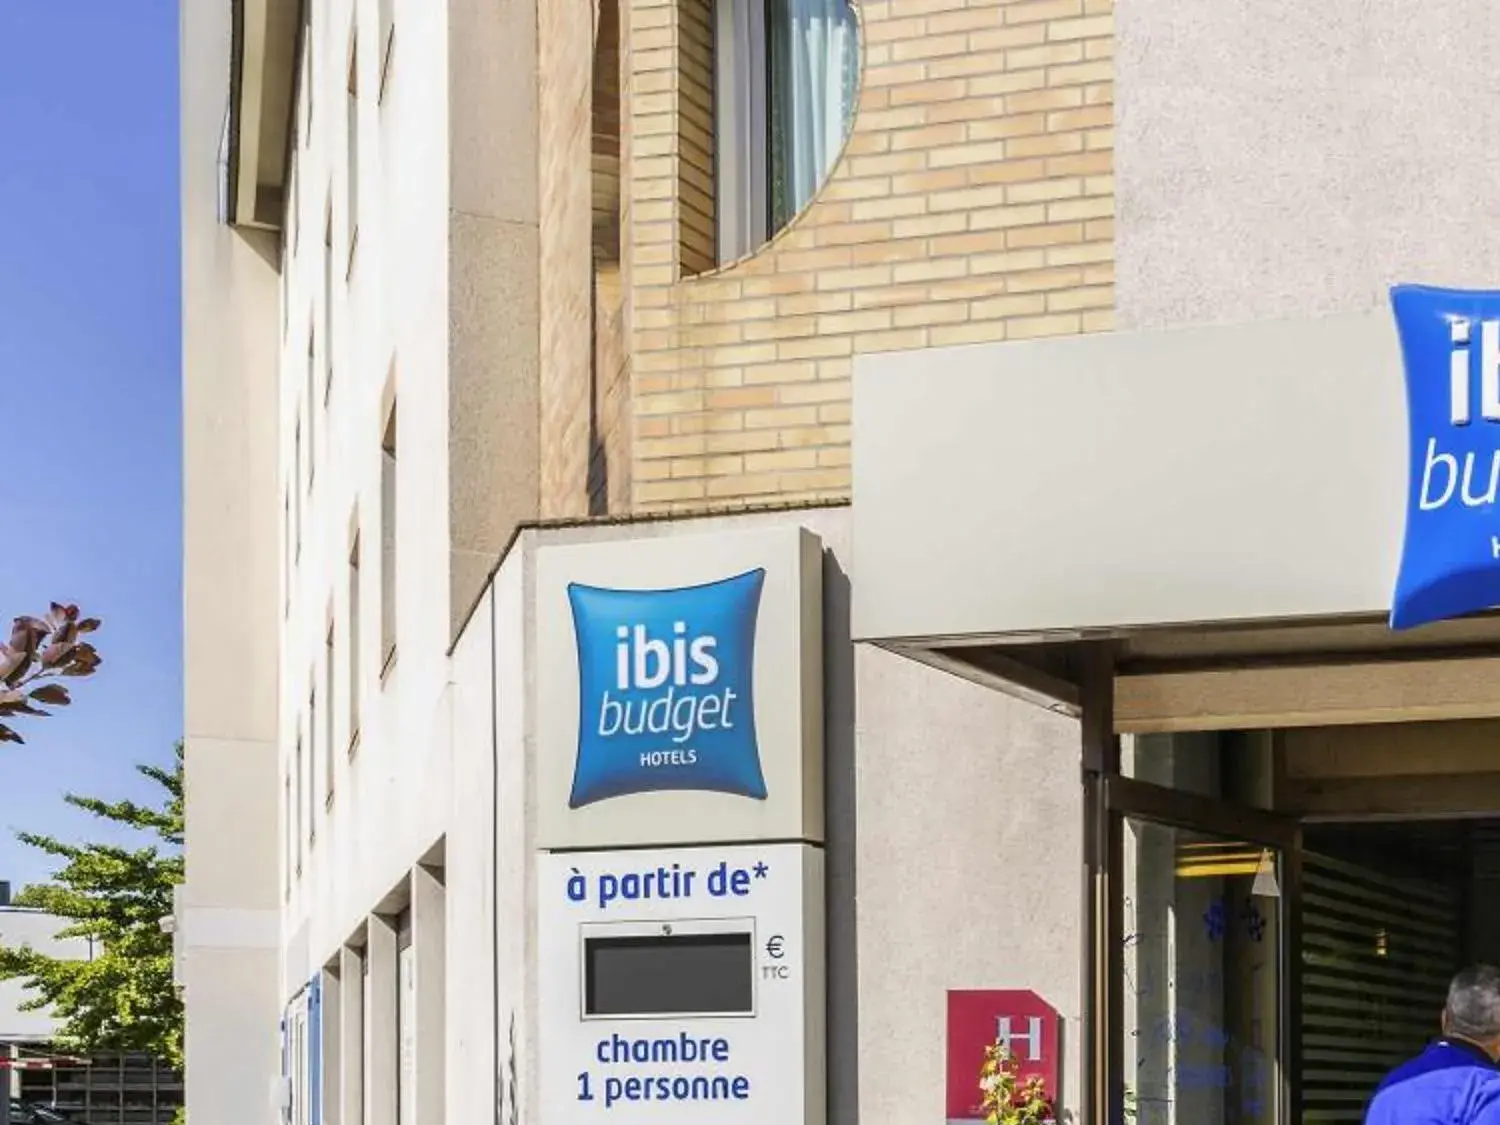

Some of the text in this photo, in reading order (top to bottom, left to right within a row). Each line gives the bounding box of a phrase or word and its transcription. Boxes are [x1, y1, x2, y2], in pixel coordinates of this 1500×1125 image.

[616, 621, 719, 690] ibis
[598, 686, 736, 743] budget
[640, 749, 697, 767] HOTELS
[567, 867, 586, 901] à
[599, 863, 696, 909] partir
[762, 966, 789, 980] TTC
[597, 1032, 730, 1063] chambre
[995, 1016, 1043, 1060] H
[577, 1072, 750, 1108] 1 personne
